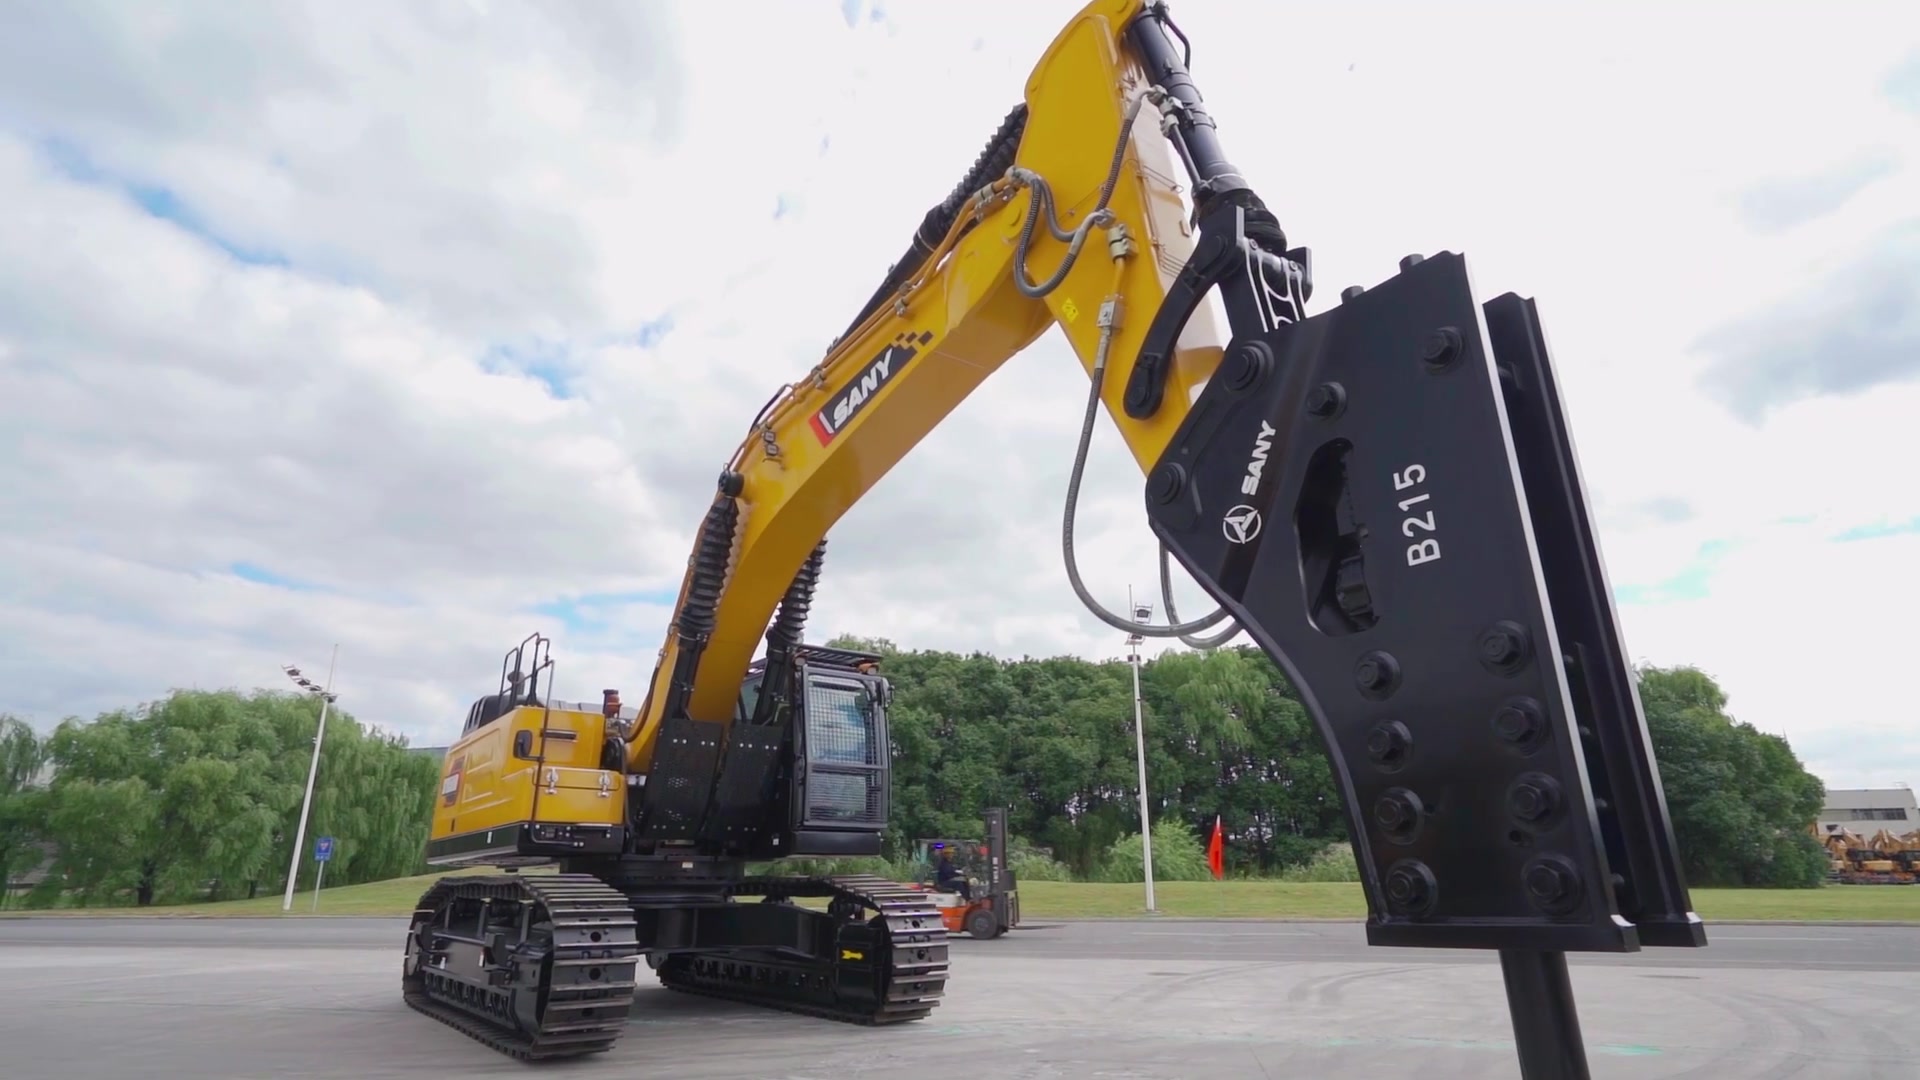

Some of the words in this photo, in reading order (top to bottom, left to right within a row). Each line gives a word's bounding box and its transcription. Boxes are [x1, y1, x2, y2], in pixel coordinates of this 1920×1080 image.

[833, 349, 893, 429] SANY
[1241, 420, 1276, 496] SANY
[1393, 464, 1441, 567] B215
